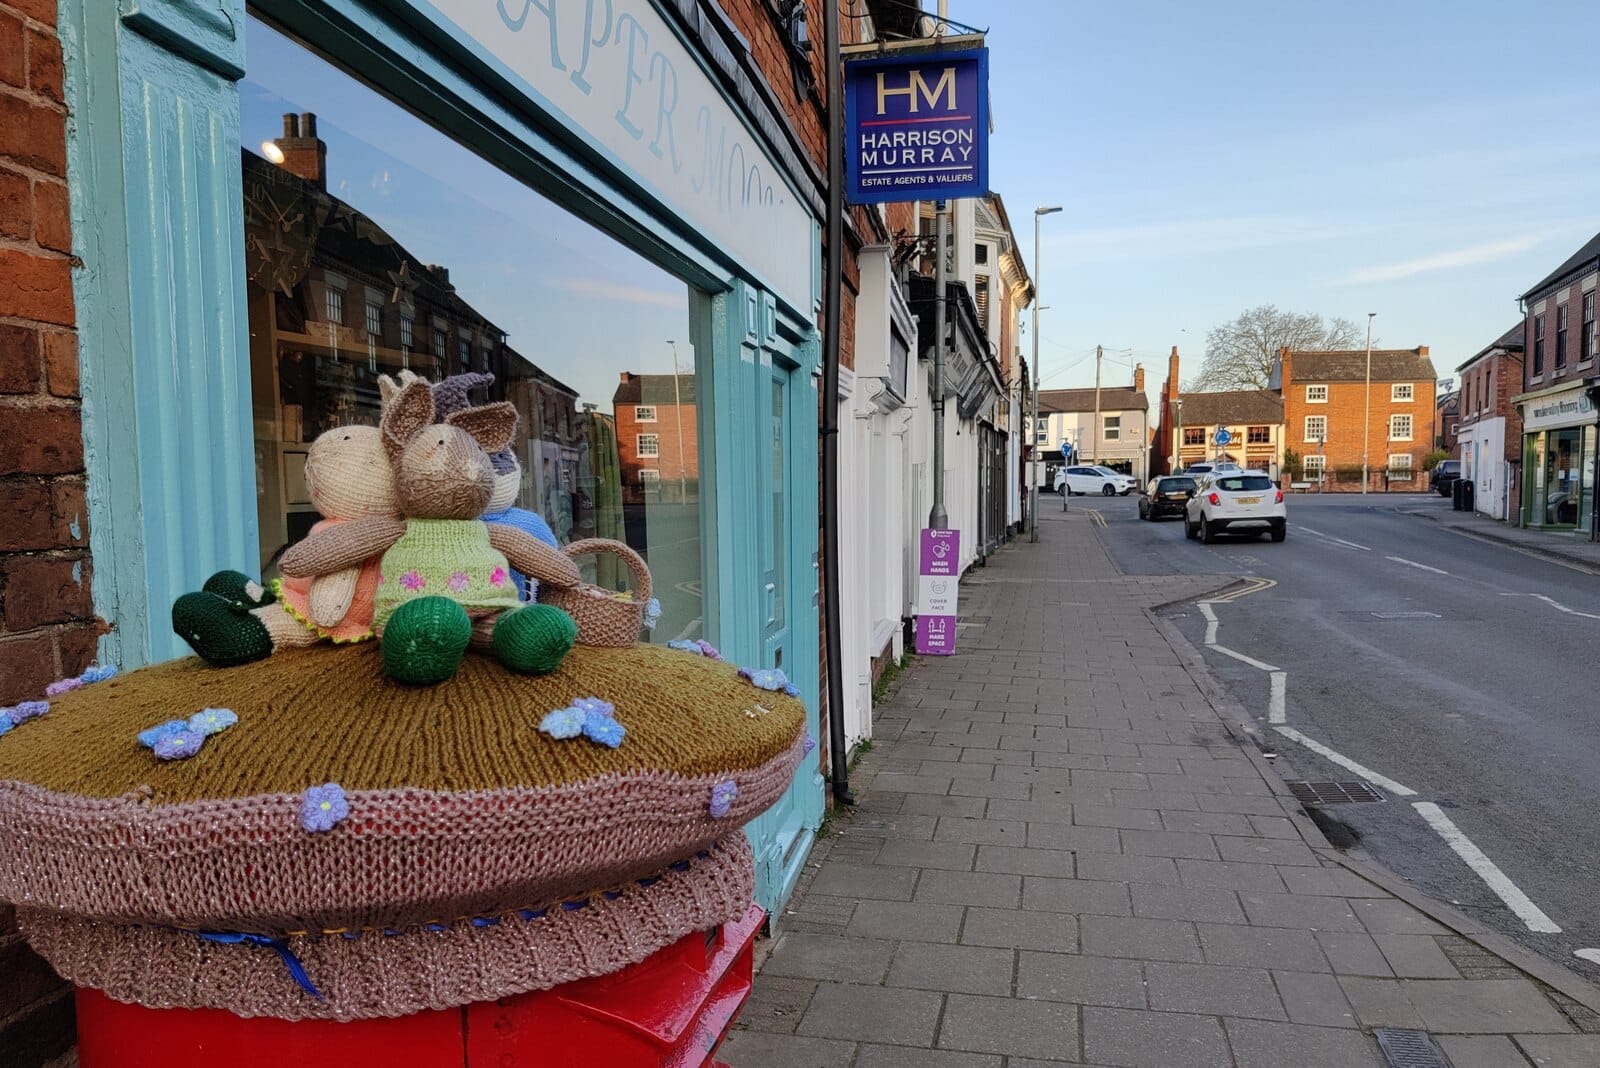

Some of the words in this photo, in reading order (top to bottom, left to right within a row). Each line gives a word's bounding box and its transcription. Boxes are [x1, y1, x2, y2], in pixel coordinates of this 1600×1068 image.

[876, 67, 957, 115] HM
[861, 128, 973, 149] HARRISON
[861, 146, 973, 167] MURRAY
[861, 177, 892, 187] ESTATE
[894, 175, 926, 185] AGENTS
[928, 175, 934, 183] &
[936, 173, 973, 183] VALUERS
